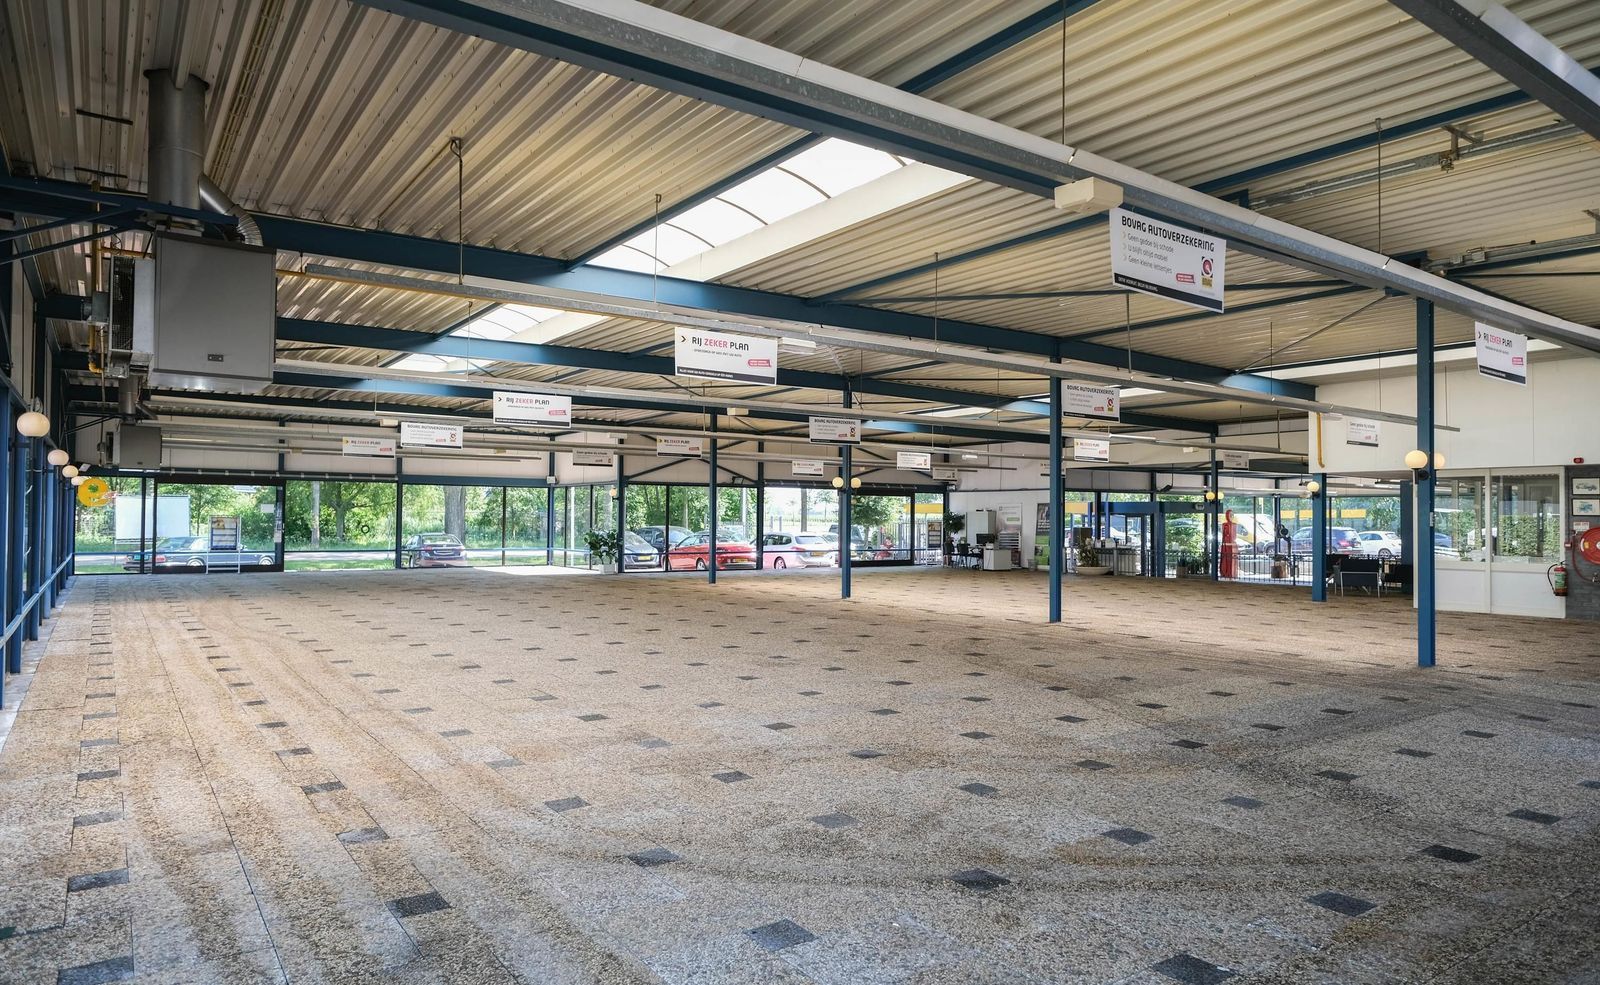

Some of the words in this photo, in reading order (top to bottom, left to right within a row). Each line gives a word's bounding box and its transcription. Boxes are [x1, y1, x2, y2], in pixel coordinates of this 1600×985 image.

[1121, 215, 1146, 233] BOVAG
[1148, 224, 1215, 252] AUTOVERZEKERING
[692, 336, 702, 346] RIJ
[704, 338, 728, 348] ZEKER
[730, 342, 749, 350] PLAN
